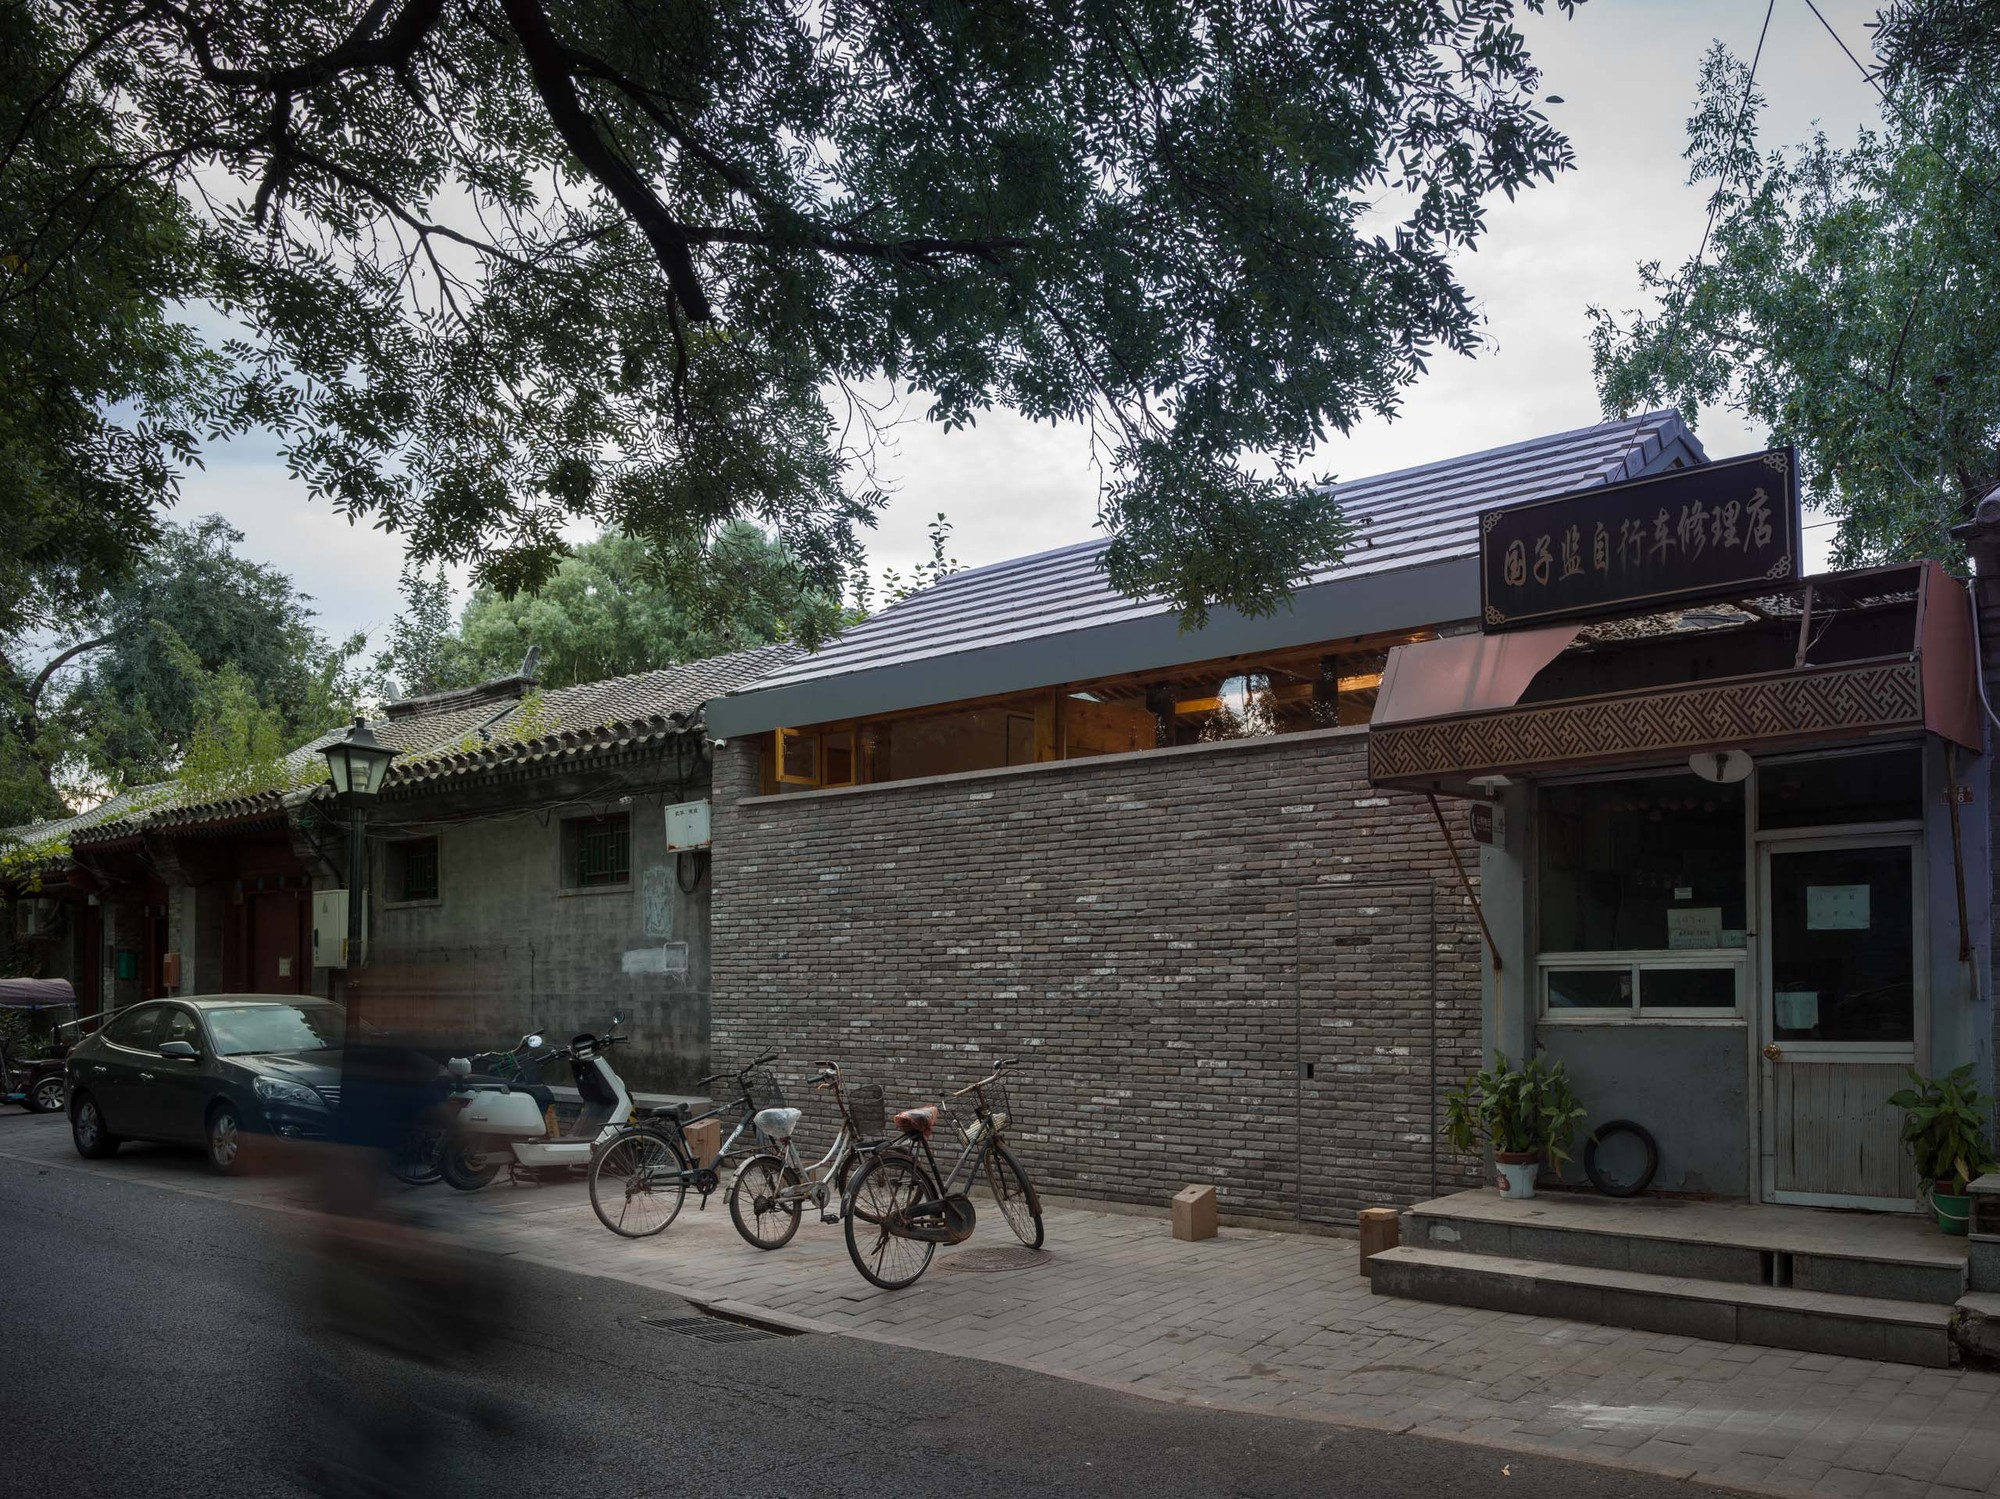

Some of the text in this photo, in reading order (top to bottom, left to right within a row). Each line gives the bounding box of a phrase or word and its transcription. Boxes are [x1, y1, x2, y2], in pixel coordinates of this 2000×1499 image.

[1504, 487, 1773, 586] 国子监自行车修理店
